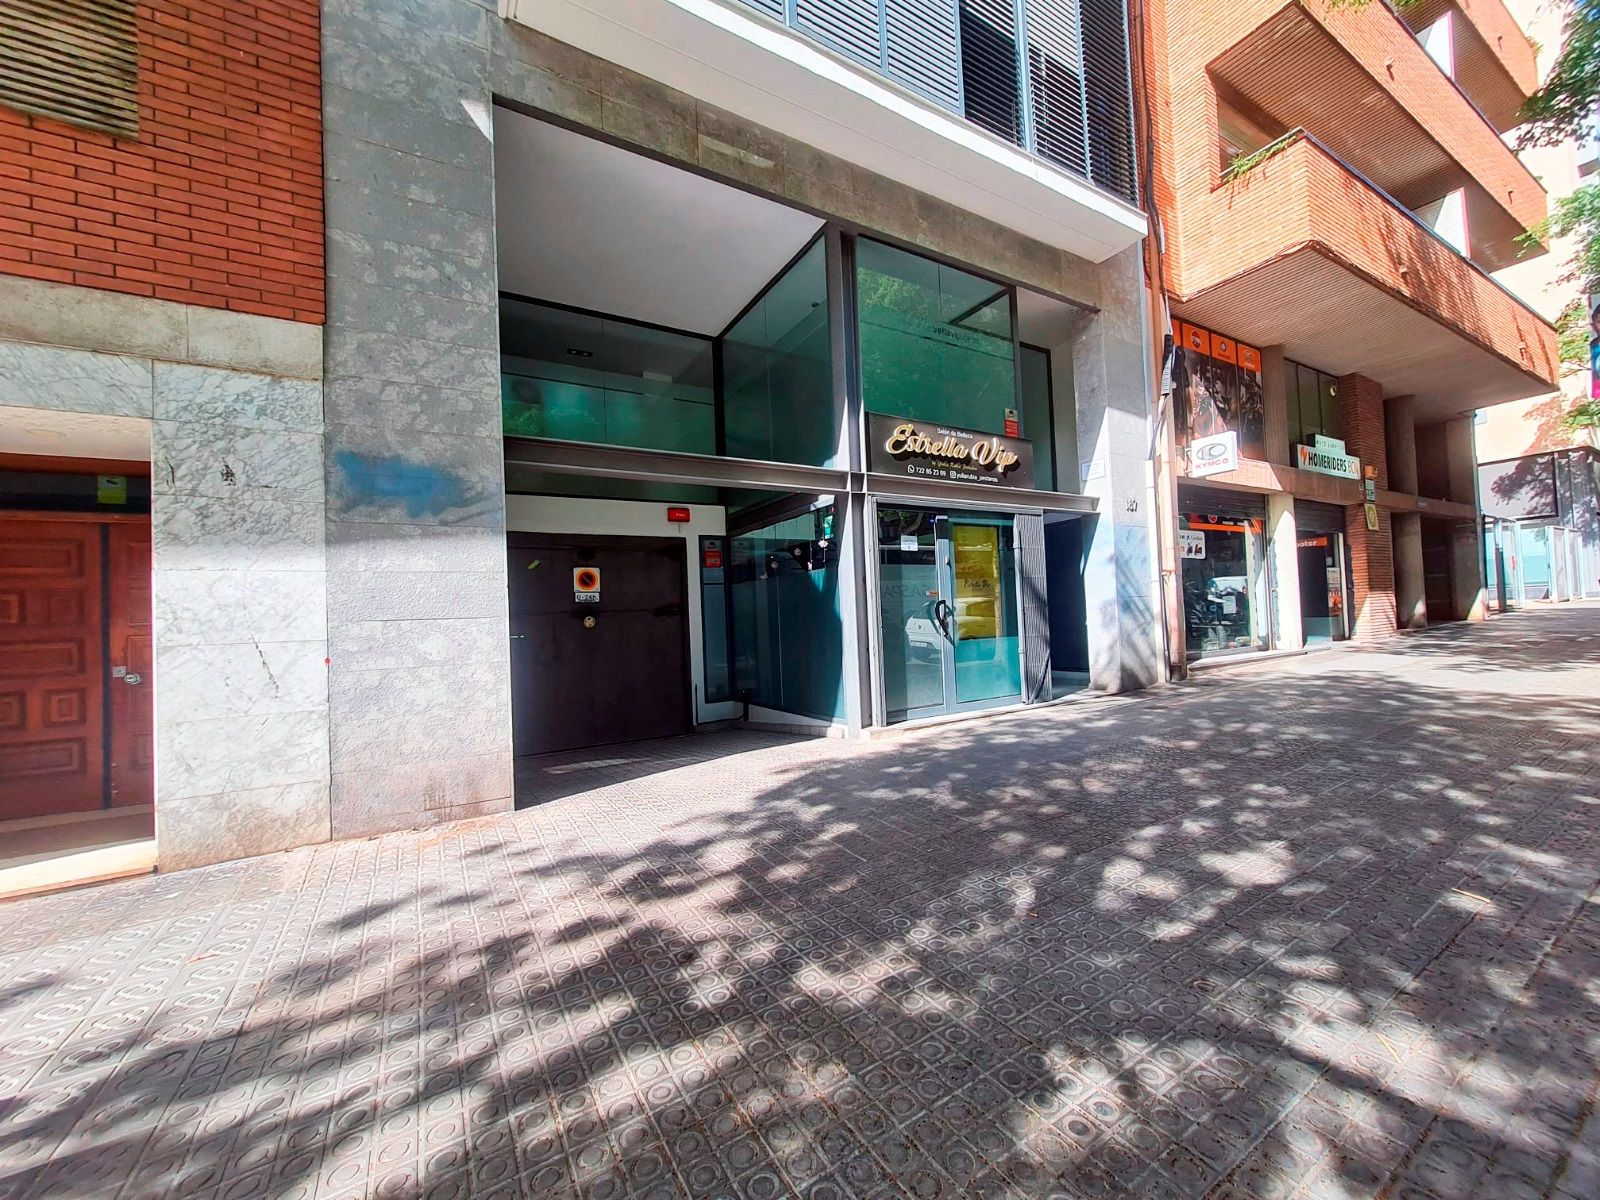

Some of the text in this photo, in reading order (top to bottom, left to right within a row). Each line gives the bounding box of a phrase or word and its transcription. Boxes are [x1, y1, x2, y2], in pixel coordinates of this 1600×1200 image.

[885, 423, 969, 459] Estrella
[971, 437, 1018, 472] Vip
[1195, 457, 1229, 470] KYMCO
[1308, 451, 1346, 473] HOMERIDERS
